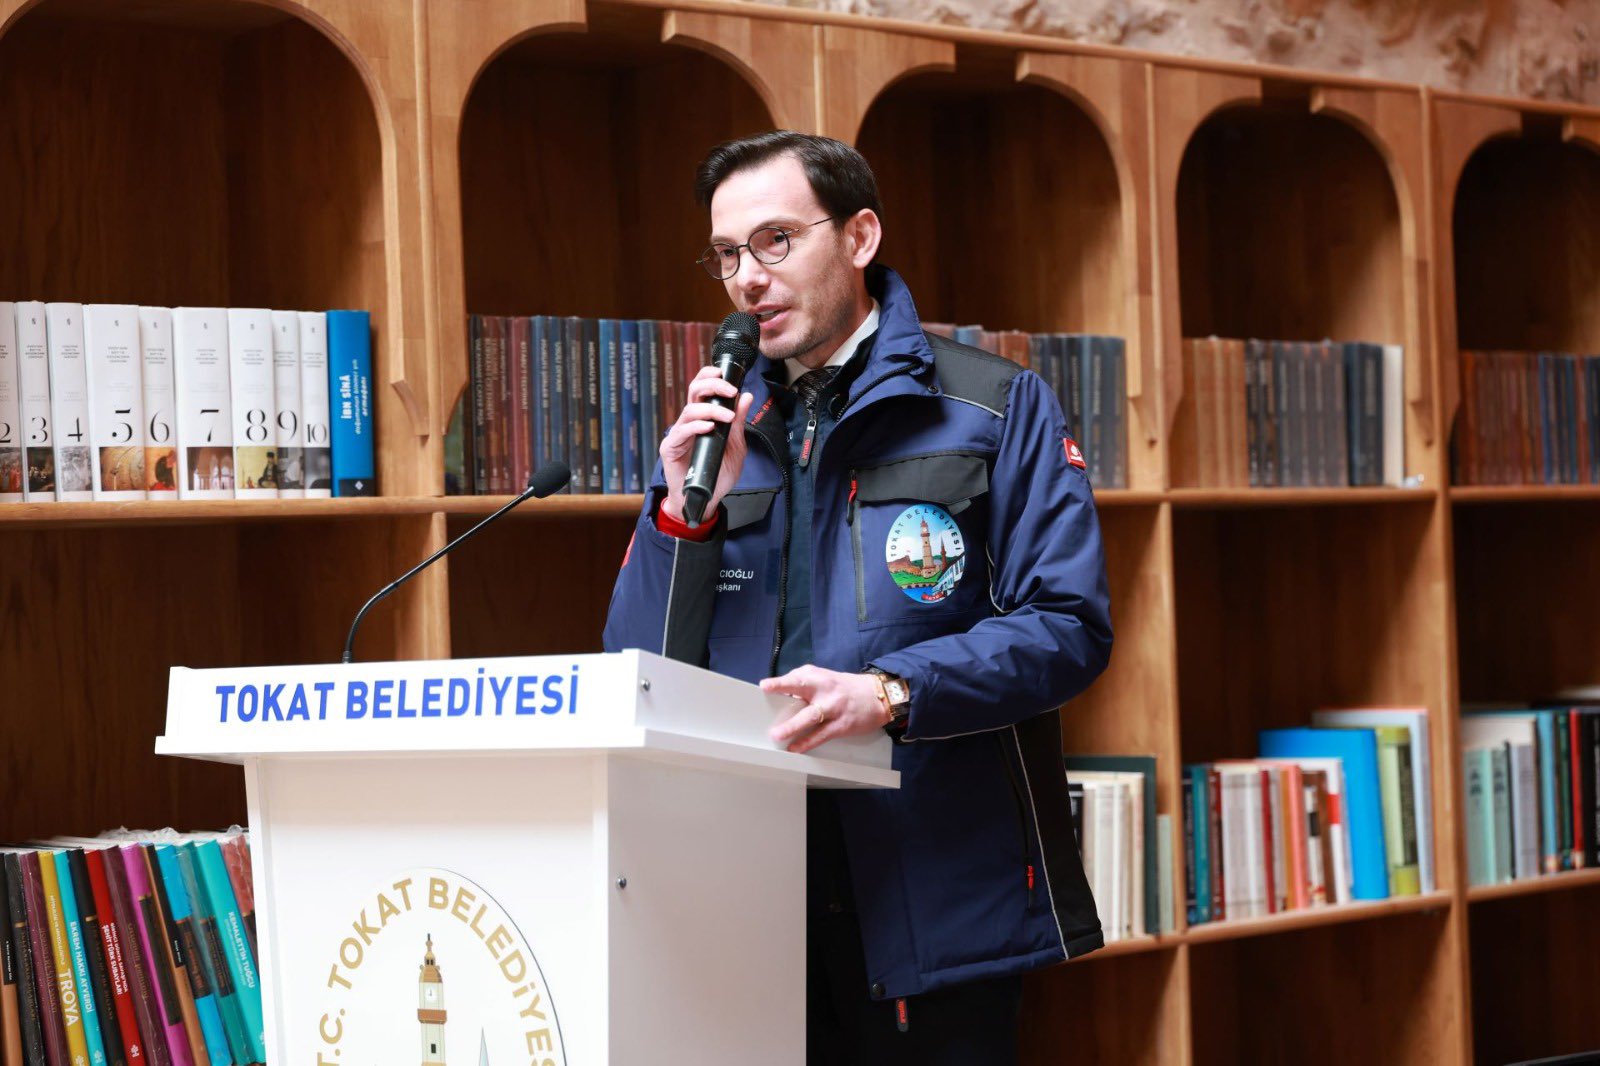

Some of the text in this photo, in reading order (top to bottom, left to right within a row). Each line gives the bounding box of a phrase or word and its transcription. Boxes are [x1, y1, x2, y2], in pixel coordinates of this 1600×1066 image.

[111, 408, 133, 443] 5
[150, 411, 170, 443] 6
[200, 409, 220, 442] 7
[246, 408, 268, 443] 8
[277, 410, 298, 440] 9
[340, 402, 352, 419] İBN
[0, 422, 12, 443] 2
[31, 416, 48, 443] 3
[67, 417, 83, 443] 4
[306, 423, 327, 443] 10
[890, 522, 904, 557] TOKAT
[215, 665, 579, 723] TOKAT BELEDİYESİ
[102, 925, 112, 943] ŞEHİT
[228, 911, 247, 960] KEMALETTİN
[243, 961, 256, 988] TUĞCU
[327, 878, 413, 990] TOKAT
[70, 921, 93, 1012] EKREM HAKKI AYVERDİ
[58, 969, 79, 1026] TROYA
